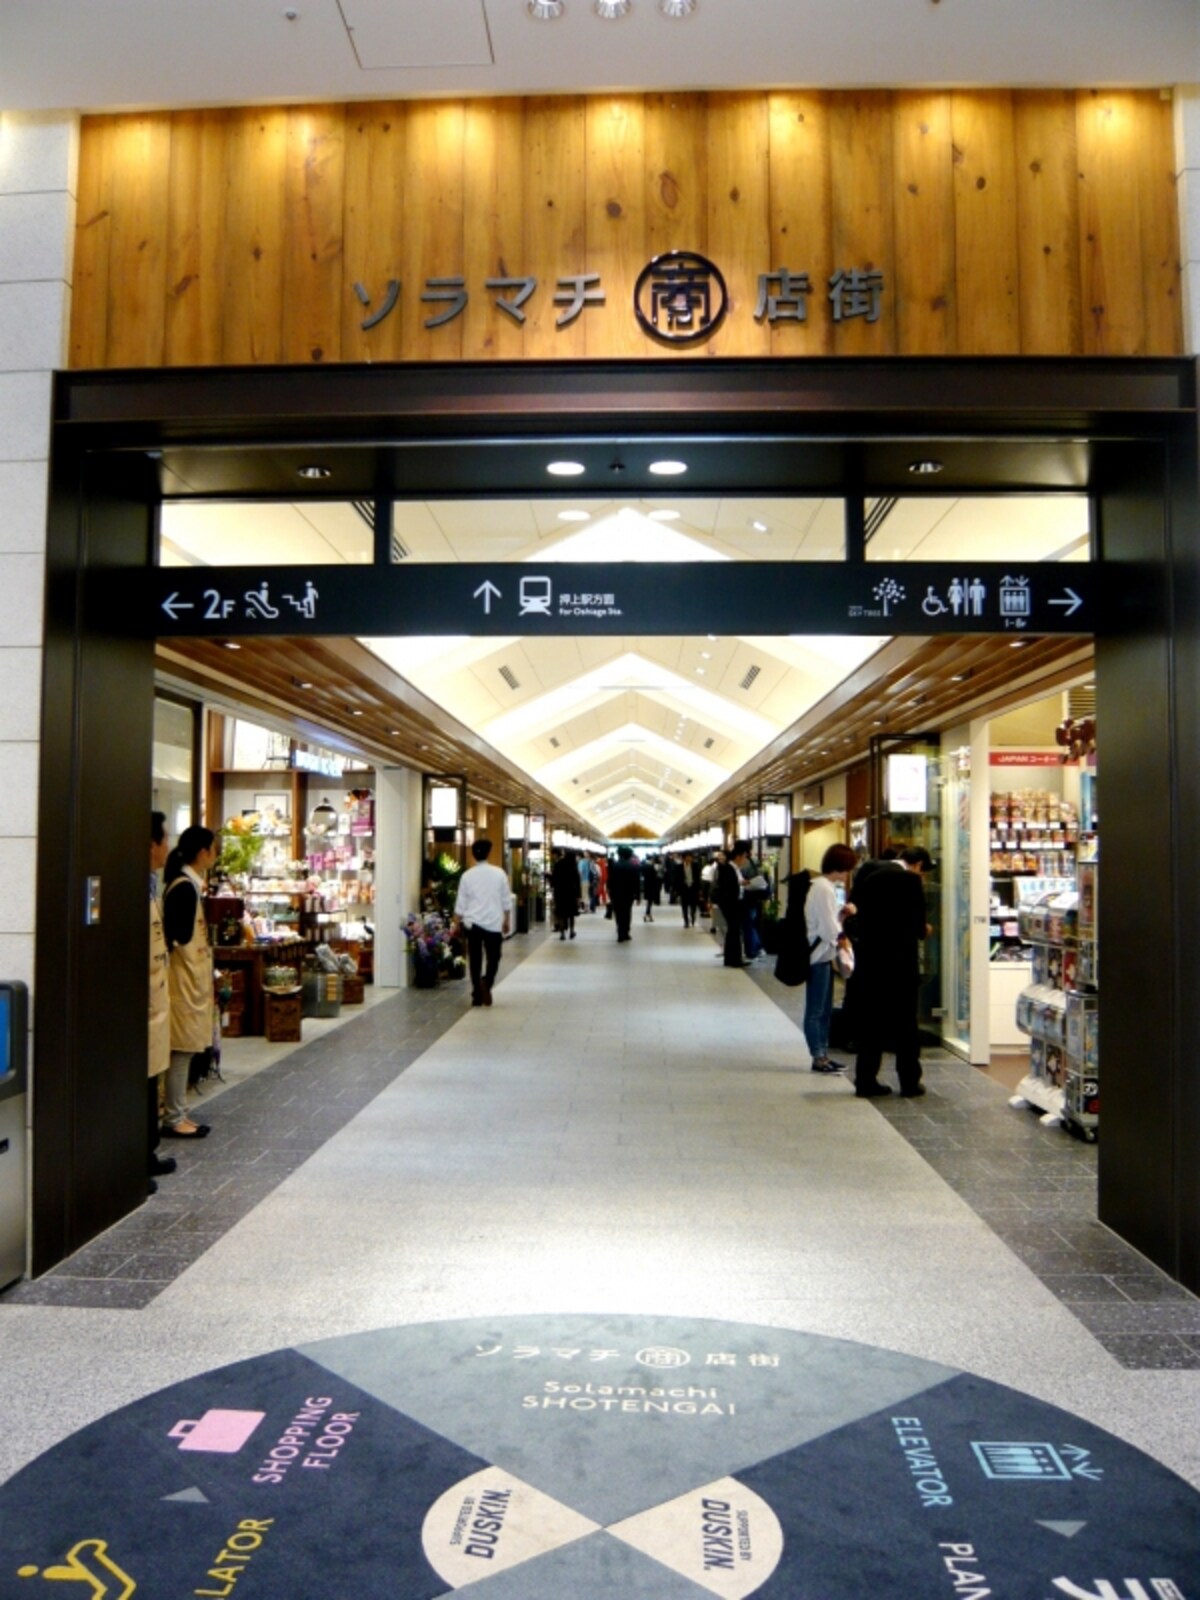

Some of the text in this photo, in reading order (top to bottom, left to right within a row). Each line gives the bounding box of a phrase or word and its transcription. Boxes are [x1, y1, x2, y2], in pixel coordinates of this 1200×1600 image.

[203, 588, 236, 619] 2F
[521, 1396, 736, 1416] SHOTENGAI
[544, 1380, 717, 1398] Solamachi
[252, 1396, 333, 1483] SHOPPING
[302, 1411, 360, 1468] FLOOR
[891, 1416, 953, 1507] ELEVATOR
